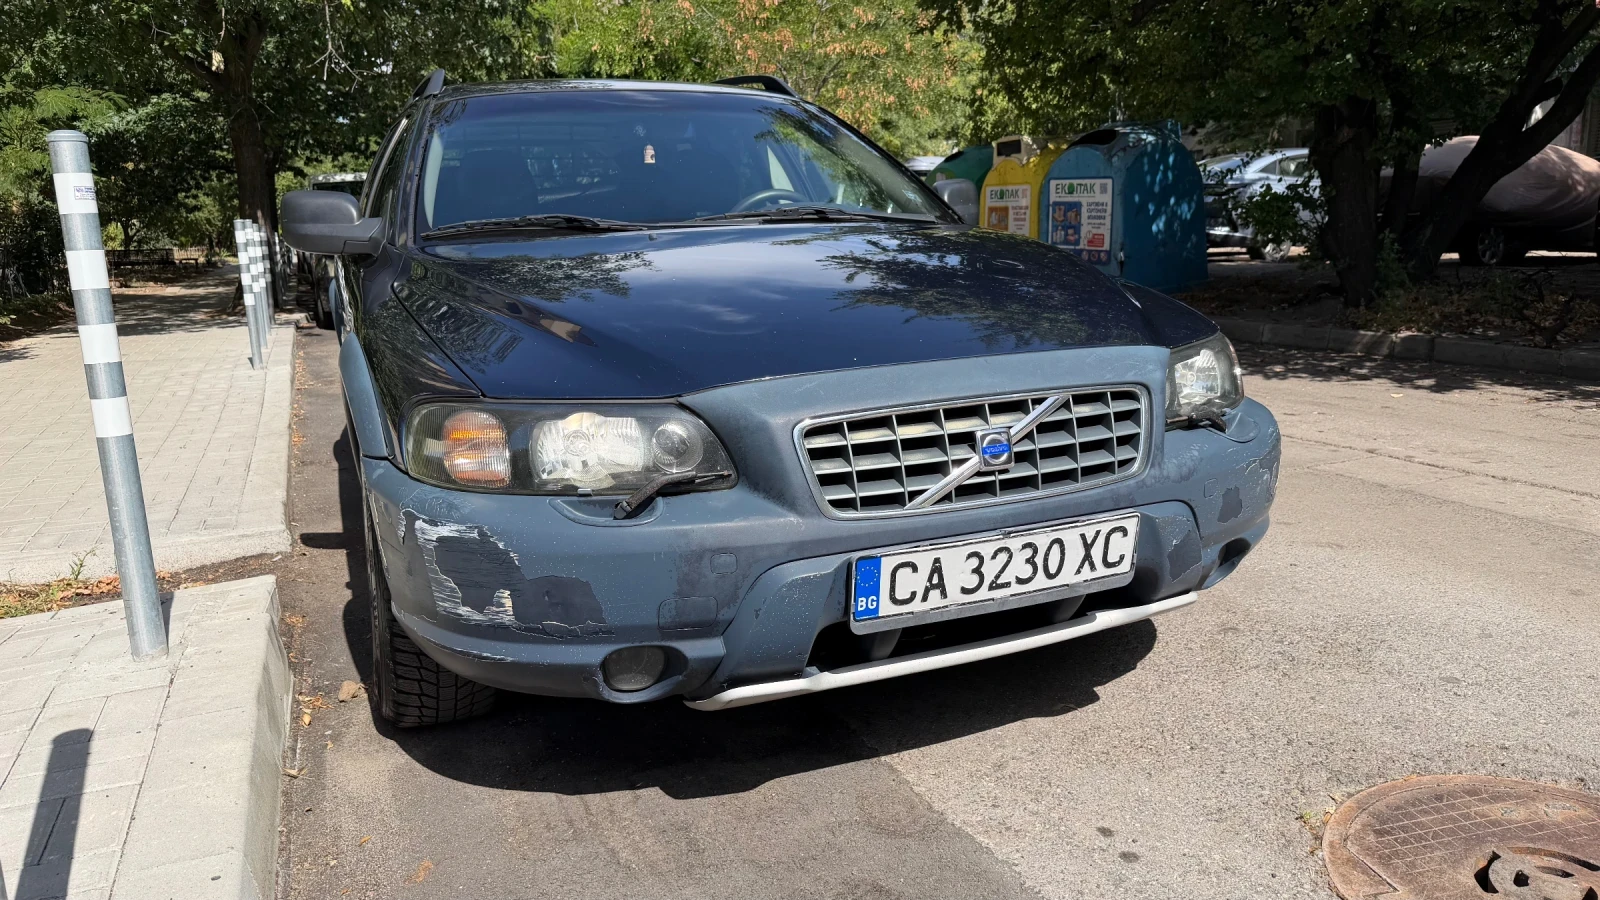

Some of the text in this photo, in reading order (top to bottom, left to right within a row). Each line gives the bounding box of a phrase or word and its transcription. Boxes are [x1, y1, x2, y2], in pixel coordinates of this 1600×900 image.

[889, 525, 1129, 607] CA 3230 XC
[857, 596, 877, 611] BG
